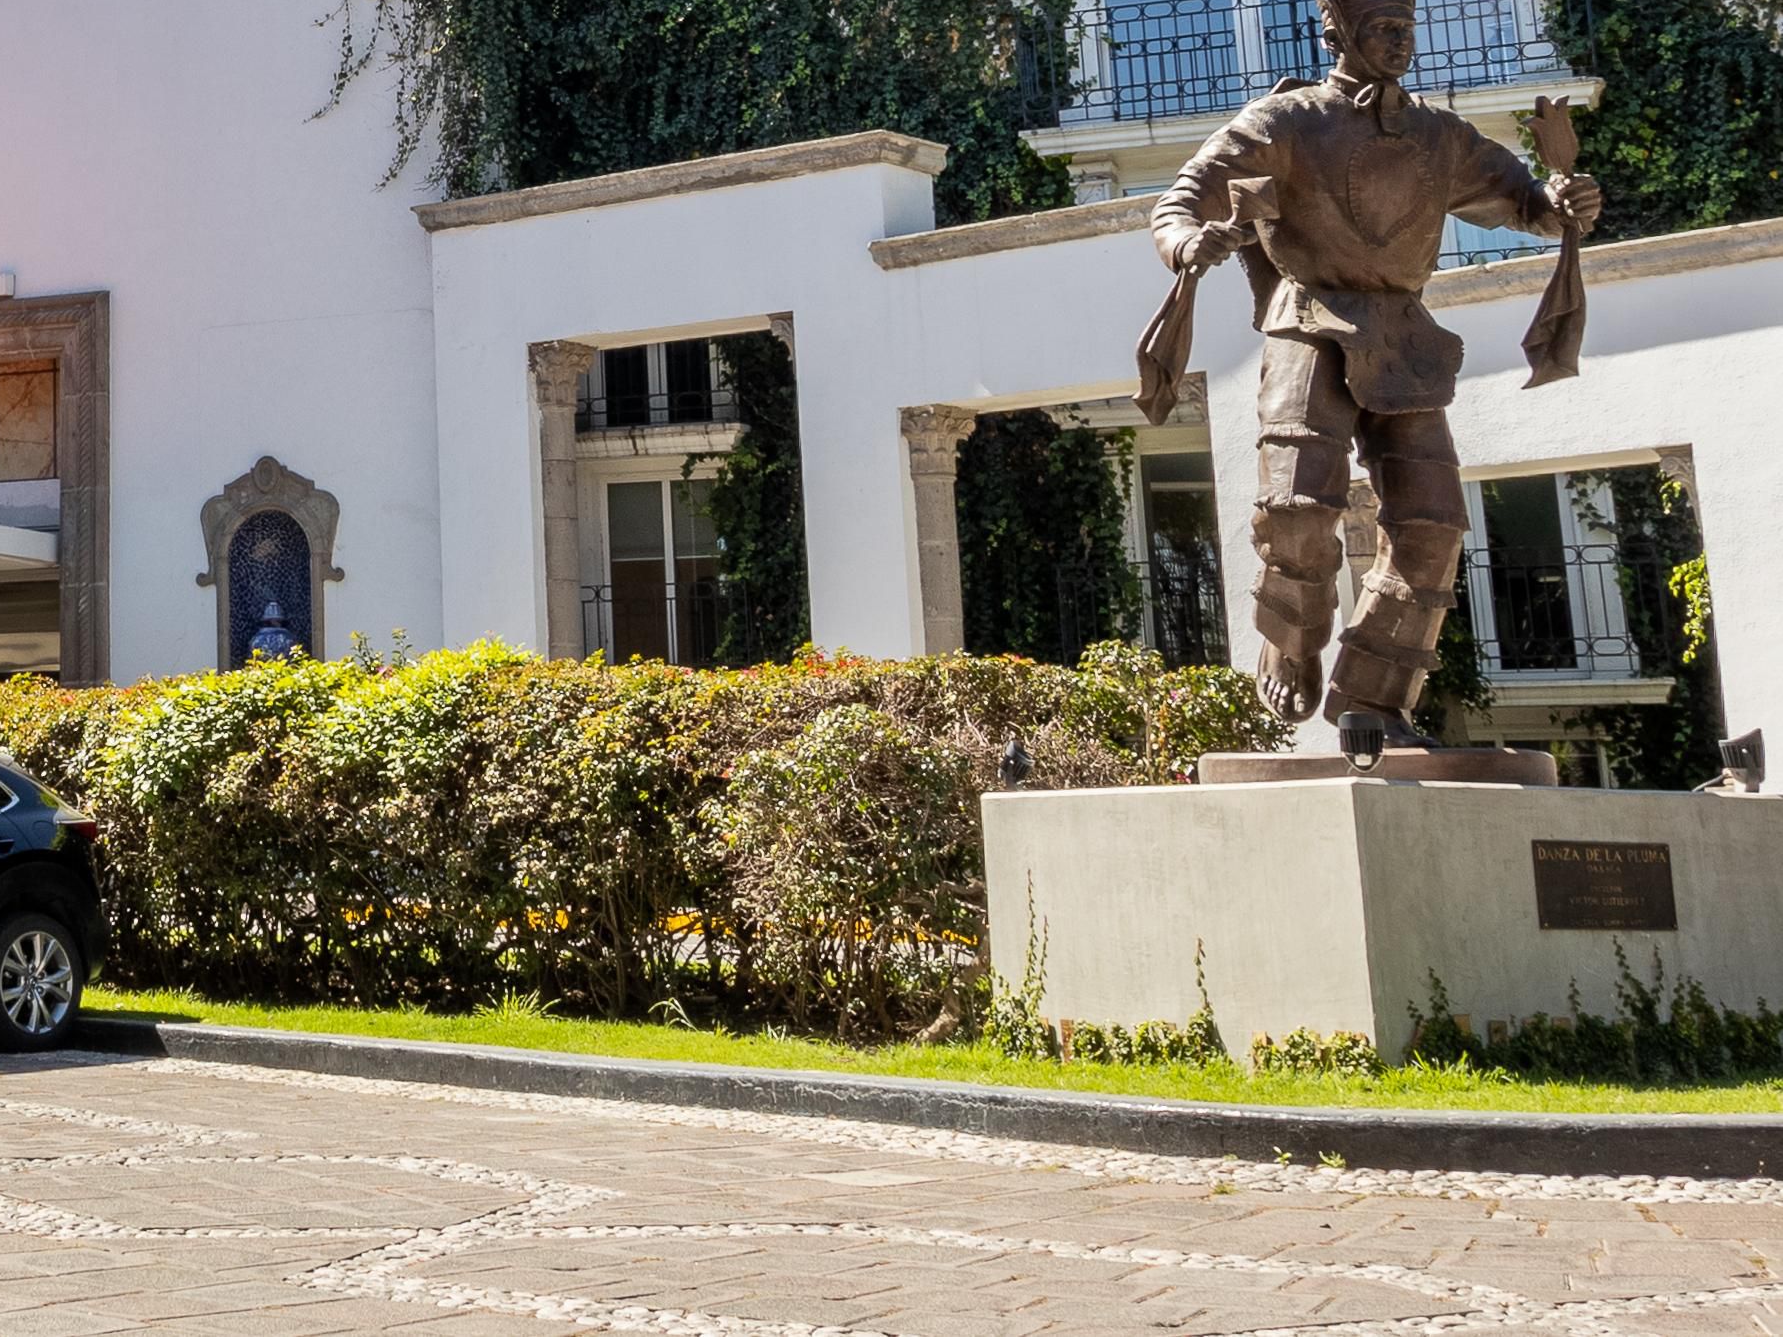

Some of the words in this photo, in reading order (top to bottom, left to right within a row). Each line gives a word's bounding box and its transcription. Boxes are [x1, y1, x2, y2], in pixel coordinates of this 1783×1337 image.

[1537, 846, 1580, 862] DANZA
[1585, 848, 1602, 862] DE
[1605, 848, 1623, 863] LA
[1627, 849, 1666, 863] PLUMA
